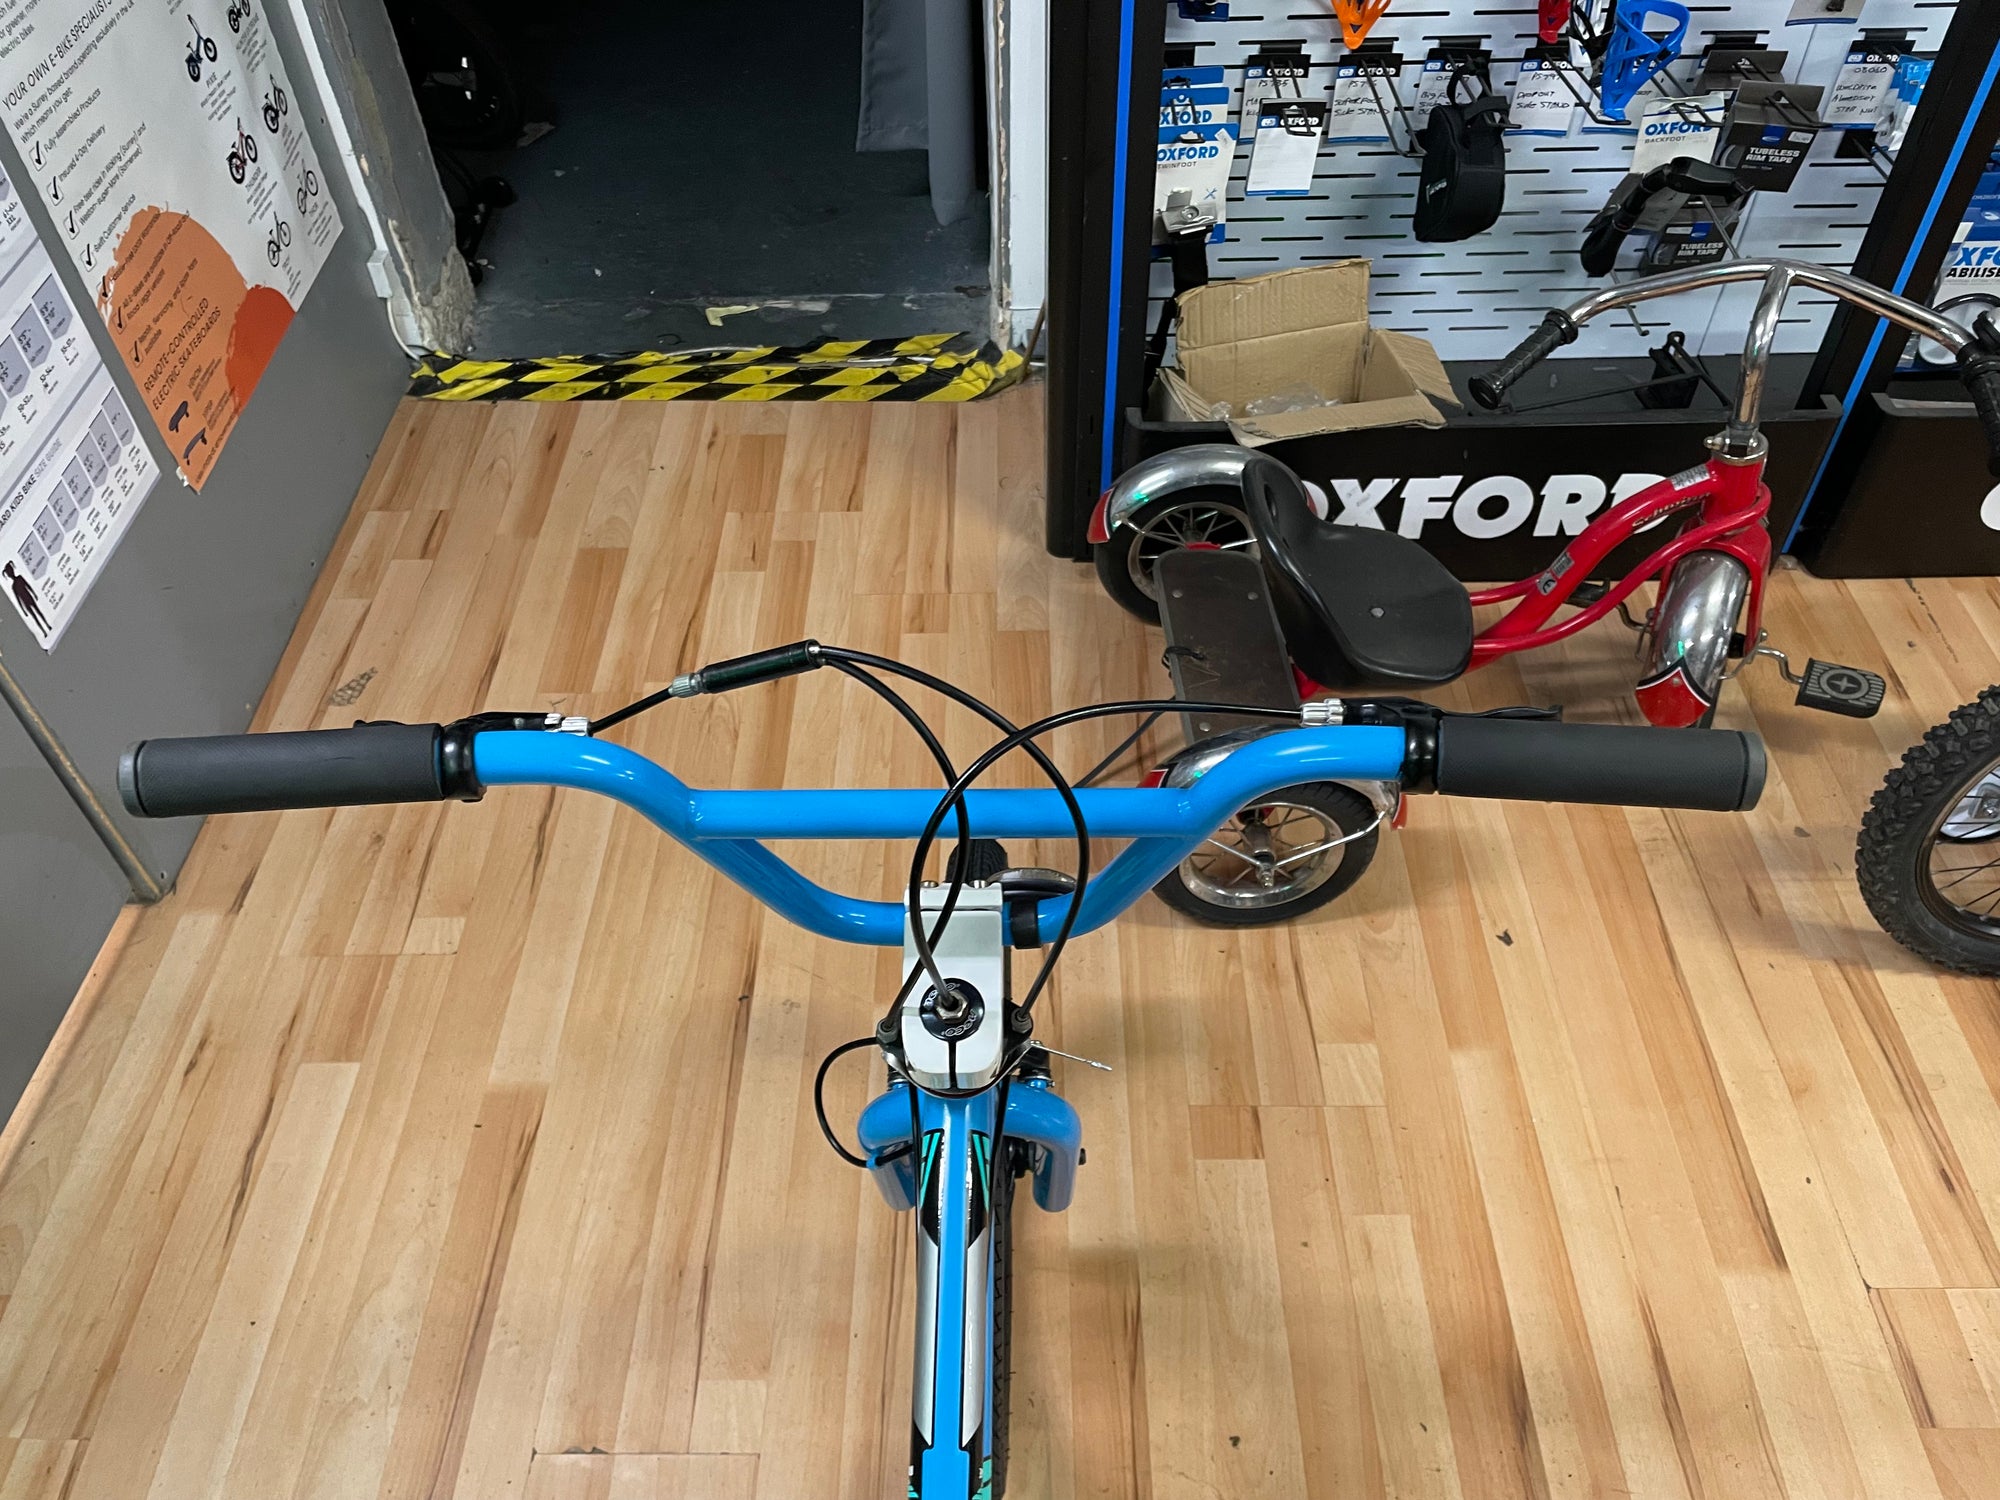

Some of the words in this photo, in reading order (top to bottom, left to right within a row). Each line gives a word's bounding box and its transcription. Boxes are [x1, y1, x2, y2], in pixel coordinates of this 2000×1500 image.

[1, 80, 28, 112] YOUR
[25, 58, 51, 88] OWN
[47, 33, 74, 68] E-BIKE
[1644, 136, 1687, 144] BACKFOOT
[1157, 145, 1219, 162] OXFORD
[1746, 153, 1767, 162] RIM
[1768, 155, 1793, 164] TAPE
[1749, 147, 1801, 158] TUBELESS
[1677, 248, 1695, 256] RIM
[1697, 248, 1719, 256] TAPE
[1680, 242, 1725, 250] TUBELESS
[143, 293, 209, 395] REMOTE-CONTROLLED
[151, 362, 180, 412] ELECTRIC
[177, 303, 221, 370] SKATEBOARDS
[9, 490, 24, 512] KIDS
[21, 472, 36, 495] BIKE
[33, 457, 47, 478] SIZE
